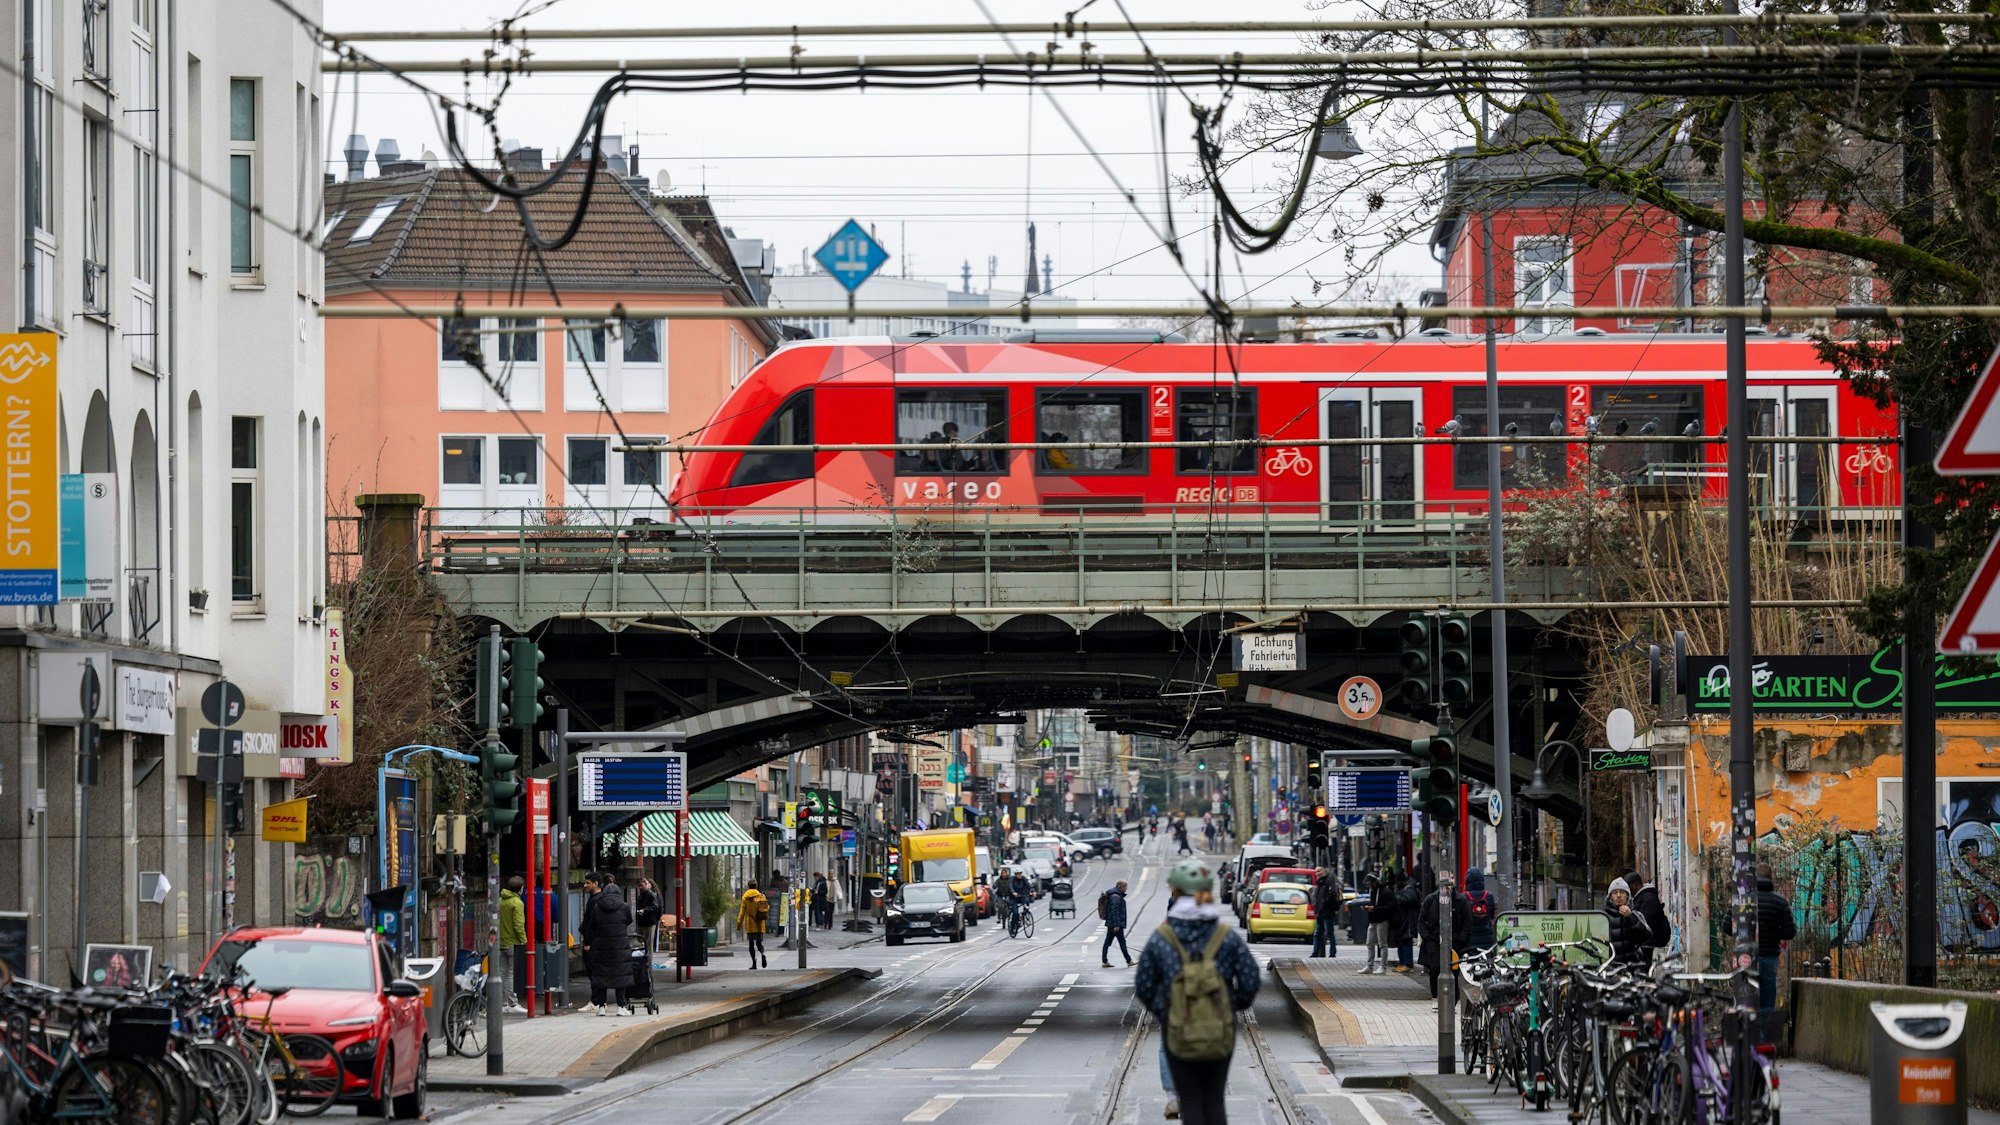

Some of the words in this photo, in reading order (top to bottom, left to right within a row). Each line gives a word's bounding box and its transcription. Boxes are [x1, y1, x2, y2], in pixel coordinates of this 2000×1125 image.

[1154, 387, 1169, 407] 2
[1571, 386, 1586, 406] 2
[7, 395, 32, 556] STOTTERN?
[902, 481, 1002, 499] vareo
[1175, 487, 1233, 502] REGIO
[1237, 488, 1257, 501] DB
[1254, 636, 1293, 649] Achtung
[329, 628, 340, 691] KINGS
[125, 673, 136, 706] The
[1698, 676, 1847, 698] BIGARTEN
[281, 724, 328, 749] IOSK
[1593, 752, 1649, 771] Station
[270, 815, 298, 823] DHL
[808, 815, 824, 824] OSK
[384, 912, 395, 930] P
[1541, 922, 1565, 932] START
[1543, 932, 1563, 941] YOUR
